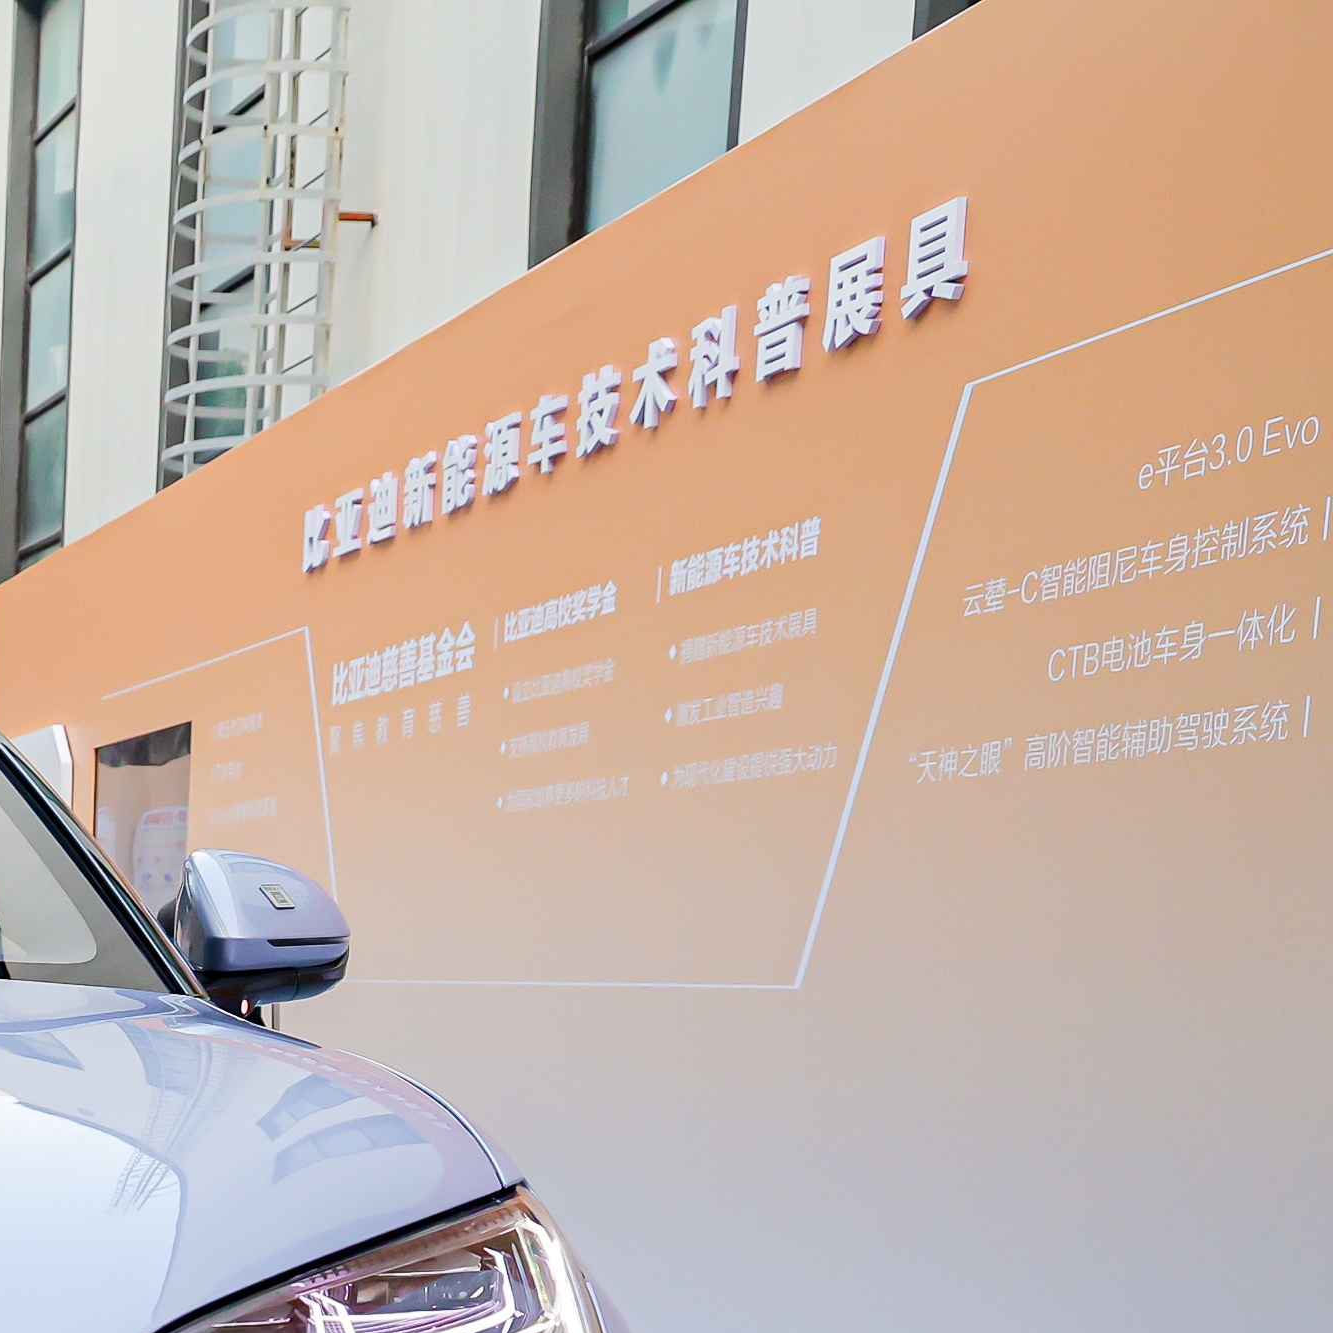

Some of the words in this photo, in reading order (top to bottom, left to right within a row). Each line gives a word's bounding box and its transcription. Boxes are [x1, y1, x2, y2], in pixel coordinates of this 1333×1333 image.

[302, 196, 969, 573] 比亚迪新能源车技术科普展具
[1137, 424, 1254, 489] e平台3.0
[1262, 415, 1320, 457] Evo
[668, 516, 822, 596] 新能源车技术科普
[504, 580, 617, 643] 比亚迪高校奖学金
[1047, 603, 1297, 682] CTB电池车身一体化
[331, 620, 476, 706] 比亚迪慈善基金会
